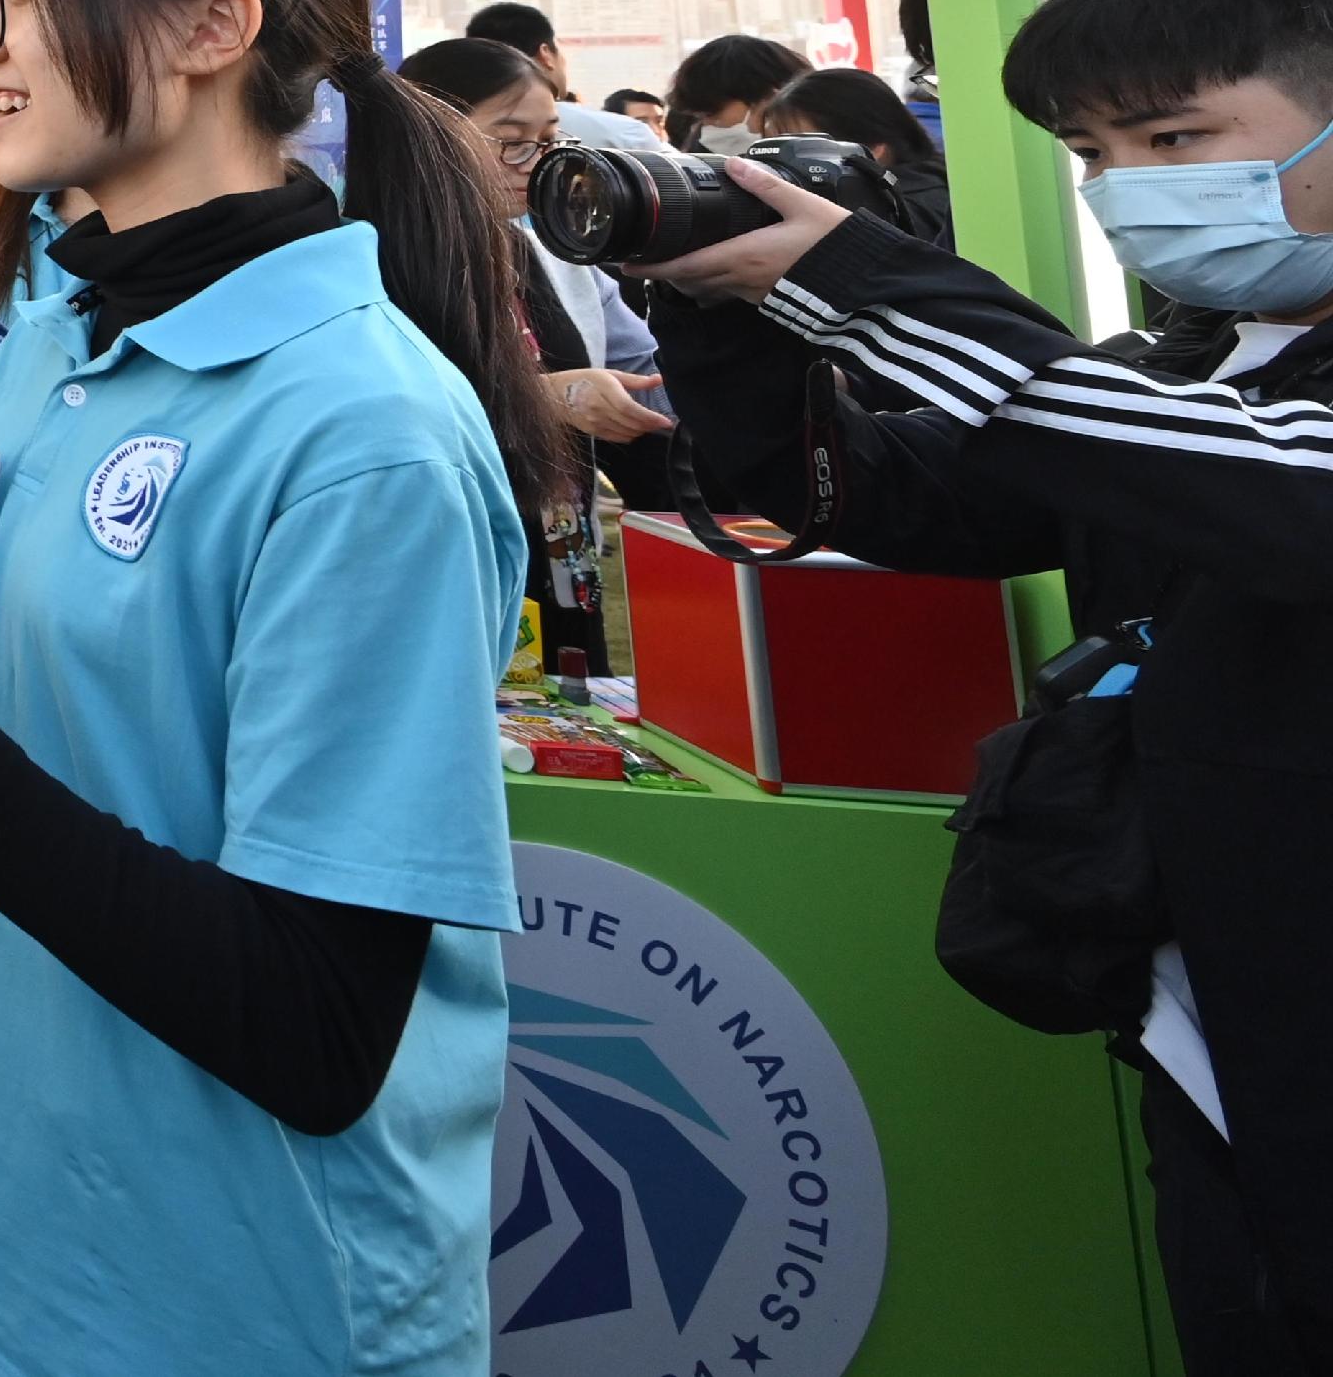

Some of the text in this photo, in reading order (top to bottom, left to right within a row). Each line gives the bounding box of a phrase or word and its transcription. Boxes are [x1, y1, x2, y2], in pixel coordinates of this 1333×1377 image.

[749, 146, 779, 155] Canon
[93, 443, 140, 501] LEADERSHIP
[814, 448, 832, 497] EOS
[641, 940, 718, 1006] ON
[718, 1010, 828, 1331] NARCOTICS
